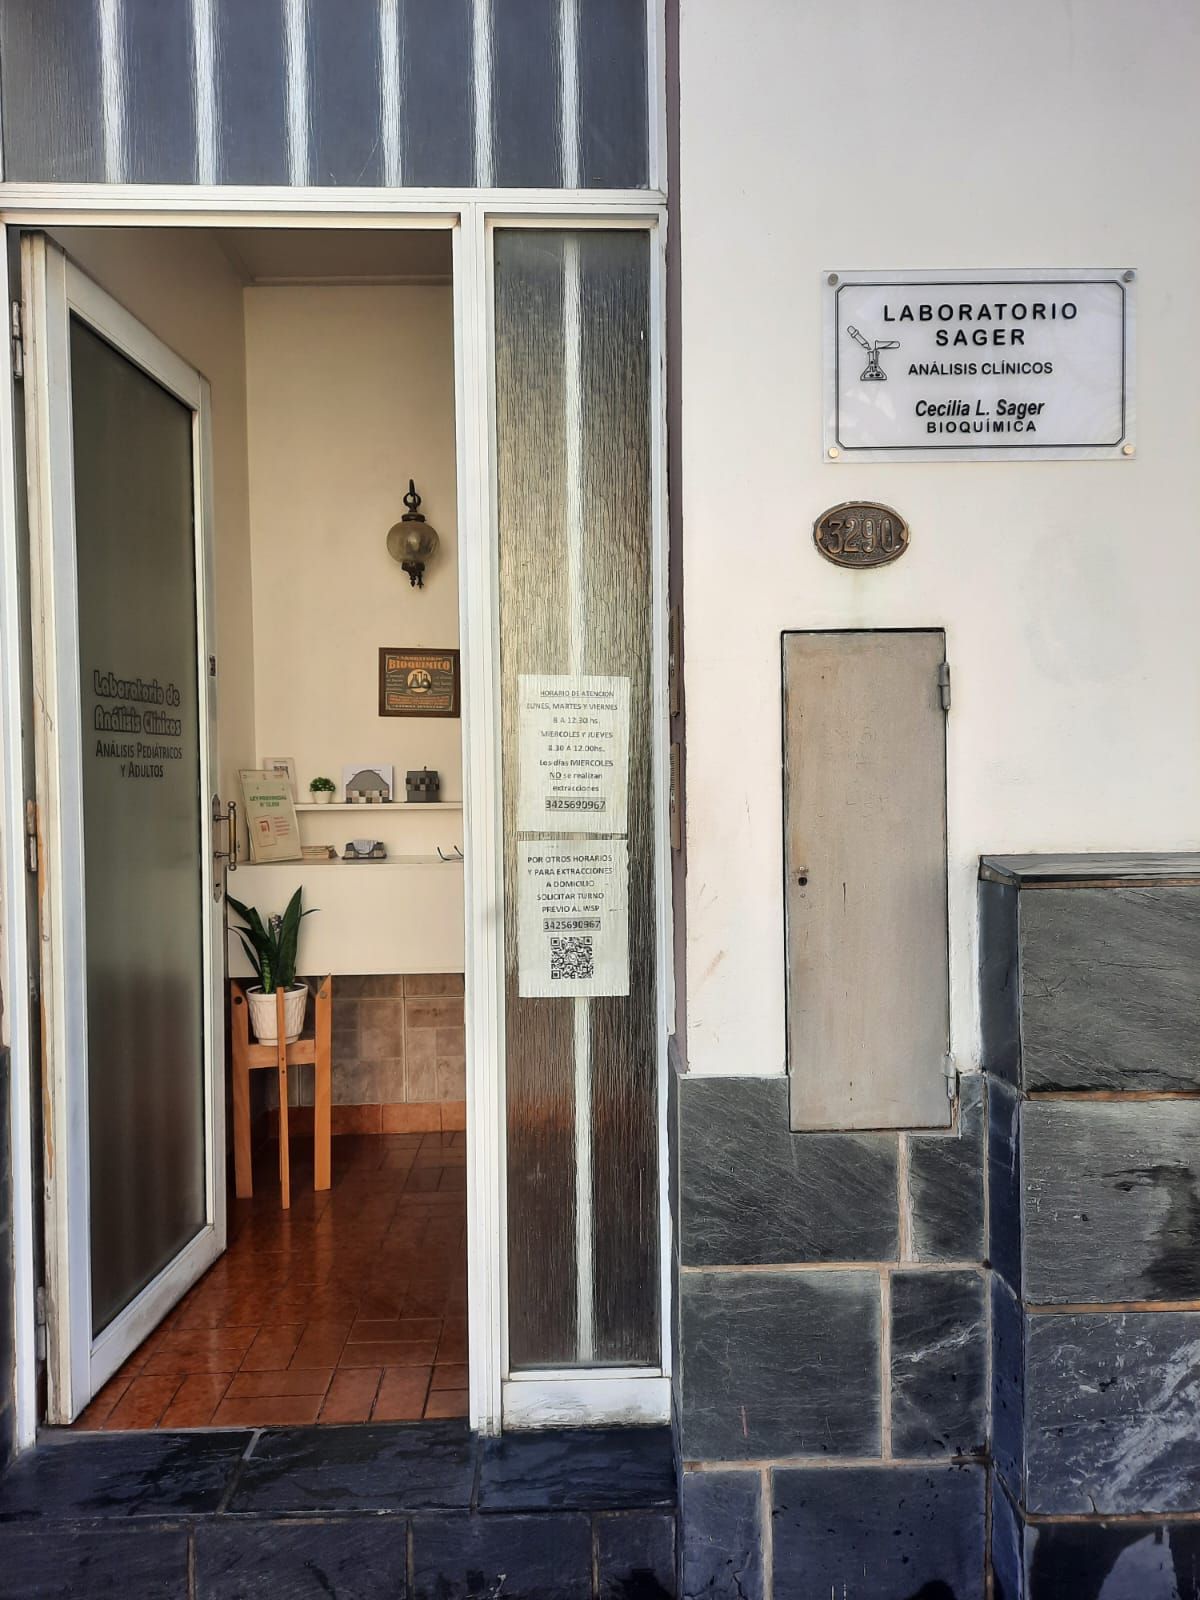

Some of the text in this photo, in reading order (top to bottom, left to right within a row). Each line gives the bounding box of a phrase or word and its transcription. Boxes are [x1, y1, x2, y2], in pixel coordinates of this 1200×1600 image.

[883, 302, 1078, 322] LABORATORIO
[935, 328, 1025, 346] SAGER
[908, 360, 1054, 376] ANÁLISIS CLÍNICOS
[915, 398, 1046, 420] Cecilia L. Sager
[926, 418, 1036, 434] BIOQUÍMICA
[827, 517, 894, 554] 3290
[94, 670, 180, 707] Laboratorio de
[128, 762, 164, 778] ADULTOS
[546, 800, 606, 810] 3425690967
